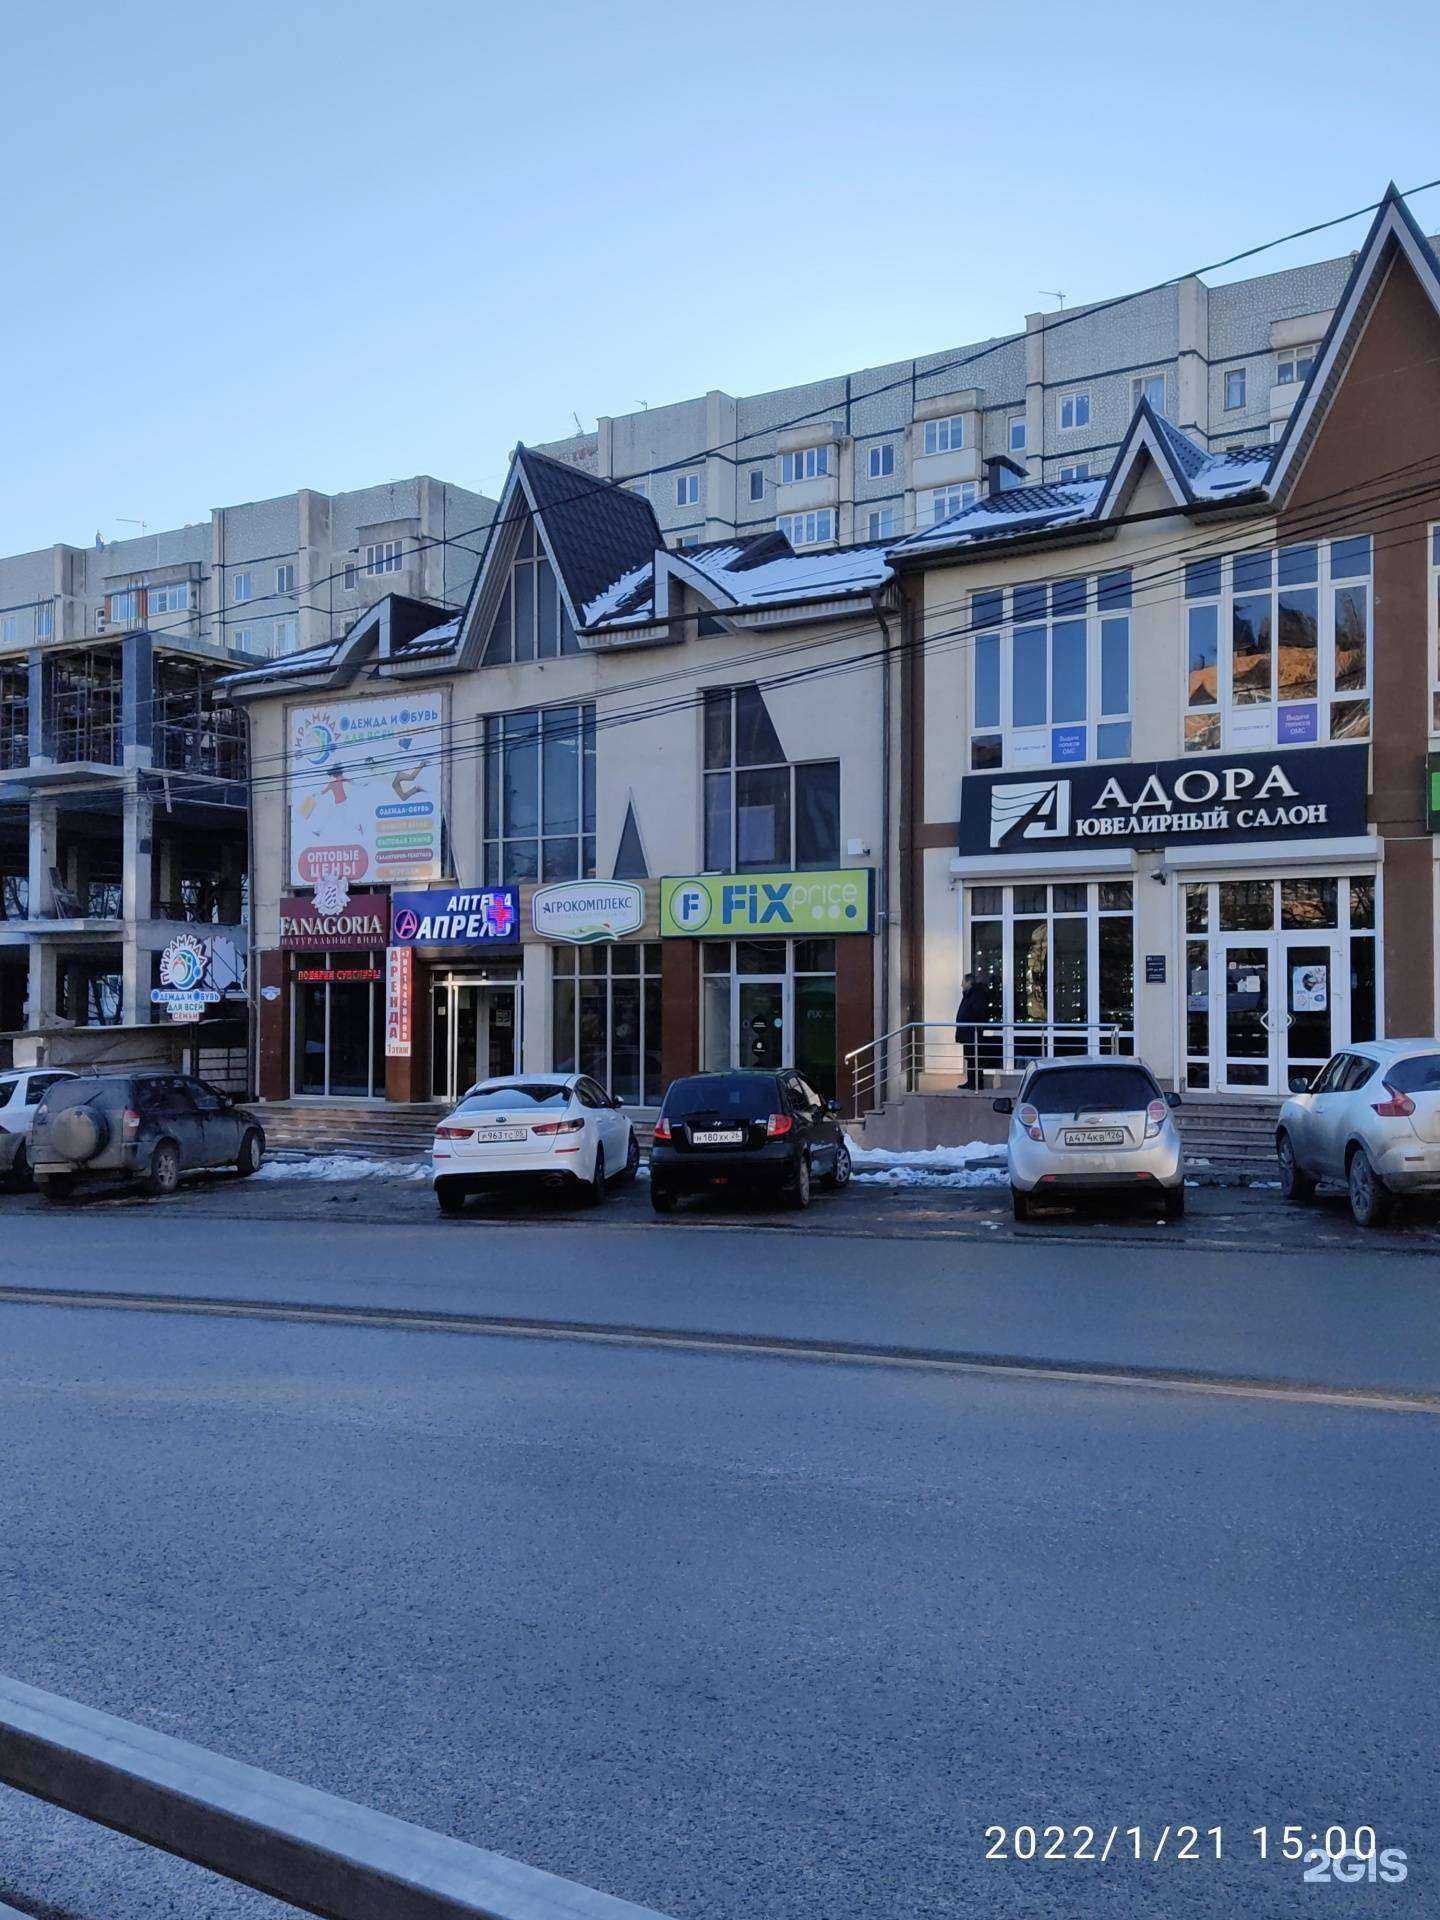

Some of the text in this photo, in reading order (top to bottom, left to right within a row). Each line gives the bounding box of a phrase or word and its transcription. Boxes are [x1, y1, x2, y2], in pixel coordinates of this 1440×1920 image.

[339, 715, 388, 731] ОДЕЖДА
[400, 709, 438, 723] ОБУВЬ
[1091, 764, 1299, 814] АДОРА
[1076, 804, 1328, 837] ЮВЕЛИРНЫЙ САЛОН
[307, 849, 360, 863] ОПТОВЫЕ
[310, 861, 356, 879] ЦЕНЫ
[446, 893, 512, 912] АПТЕА
[543, 896, 632, 914] АГРОКОМПЛЕКС
[280, 915, 384, 936] FANAGORIA
[281, 936, 384, 945] НАТУРАЛЬНЫЕ ВИНА
[160, 934, 208, 985] ПИРАМИДА
[388, 950, 399, 1039] АРЕНДА
